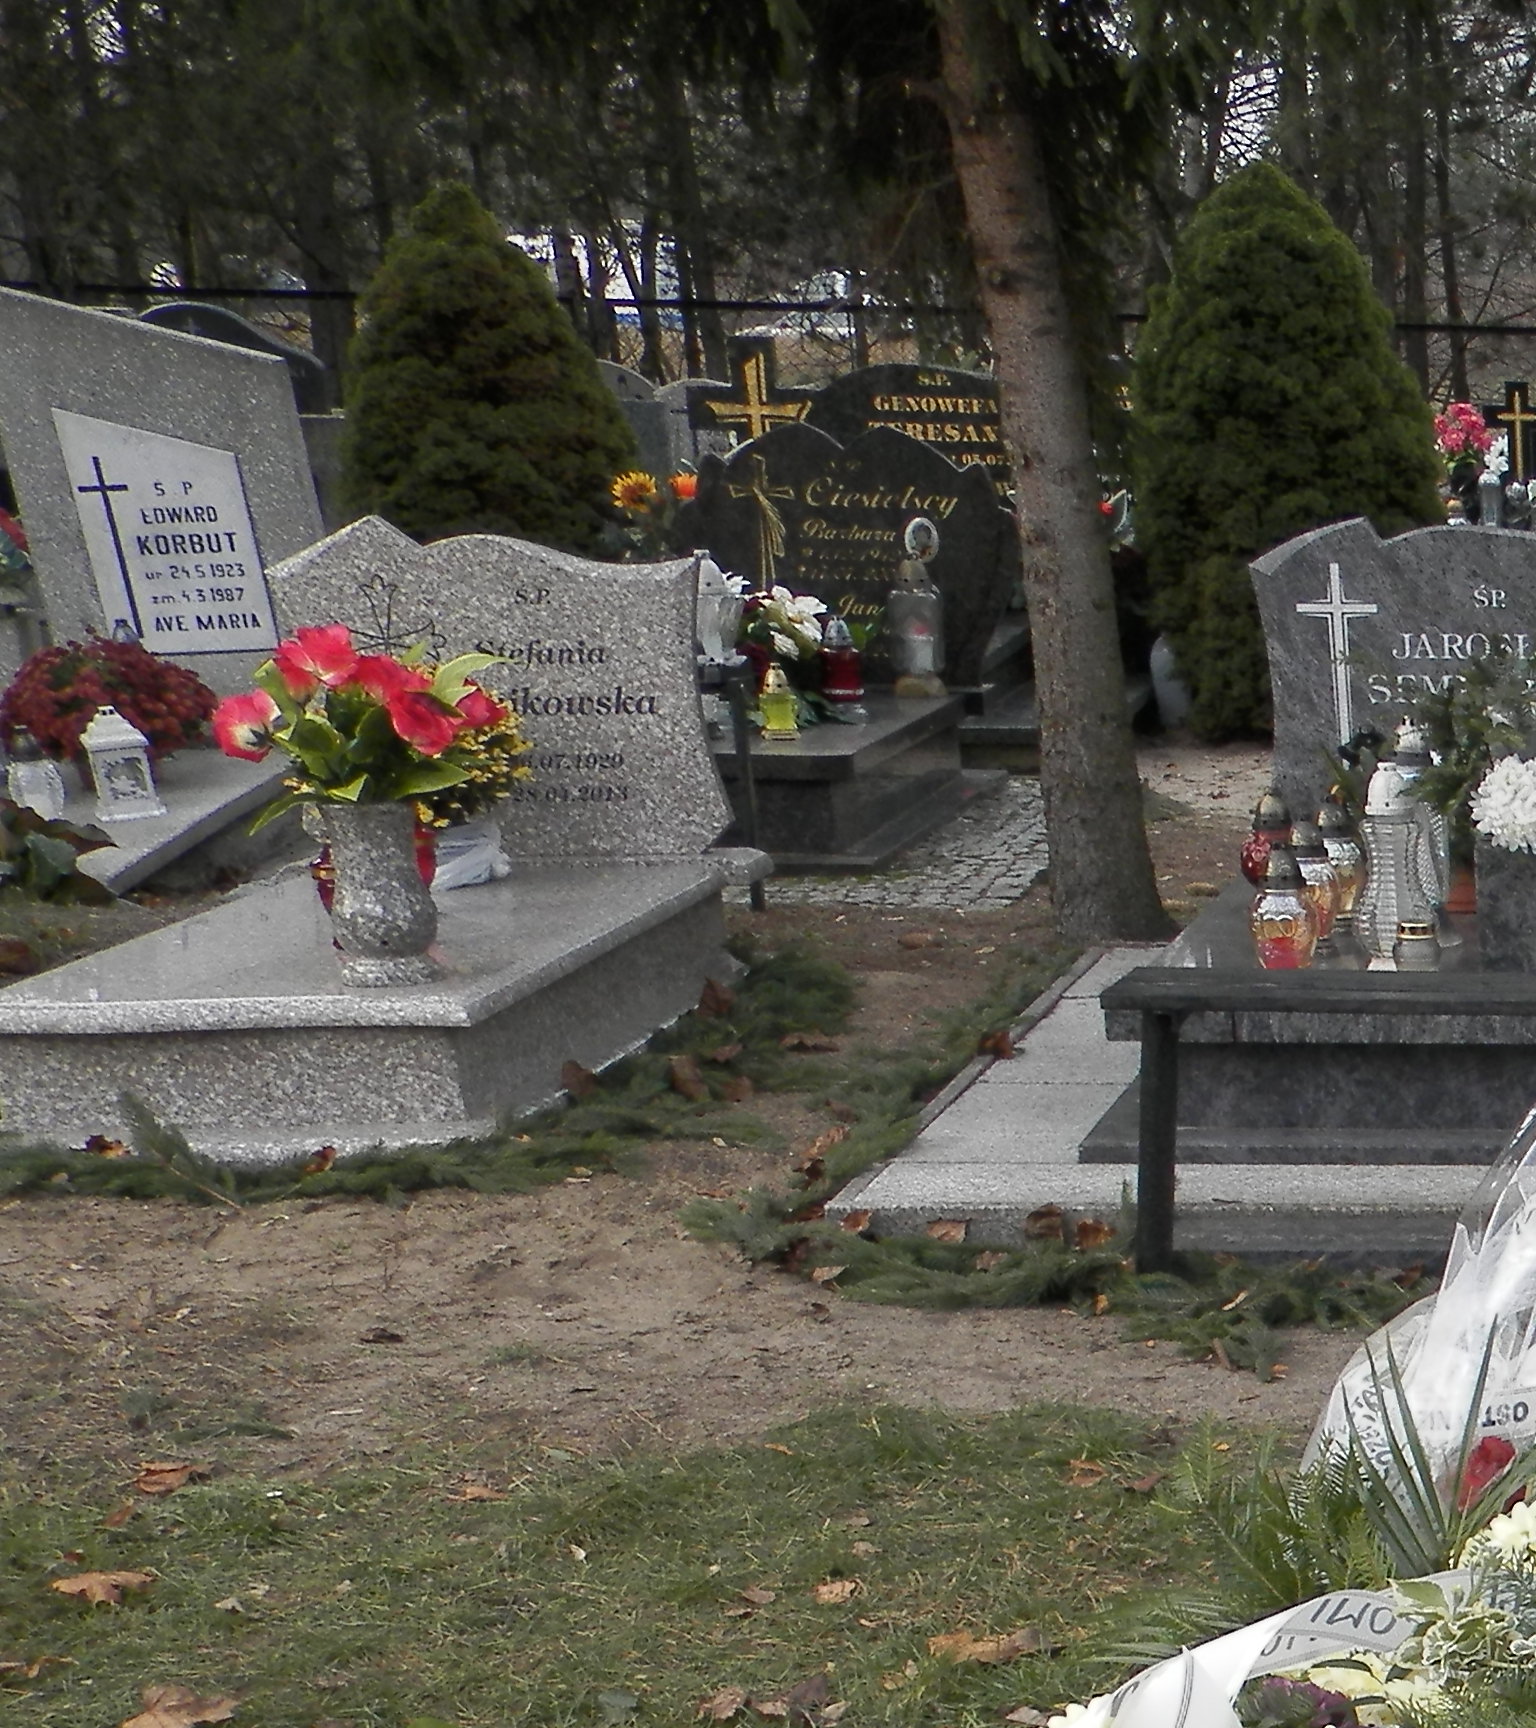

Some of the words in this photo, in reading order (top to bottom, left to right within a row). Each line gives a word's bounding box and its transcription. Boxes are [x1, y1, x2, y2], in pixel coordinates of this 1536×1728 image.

[140, 505, 219, 525] EDWARD
[136, 532, 238, 556] KORBUT
[154, 614, 190, 633] AVE
[195, 612, 262, 632] MARIA
[499, 685, 659, 716] ikowska
